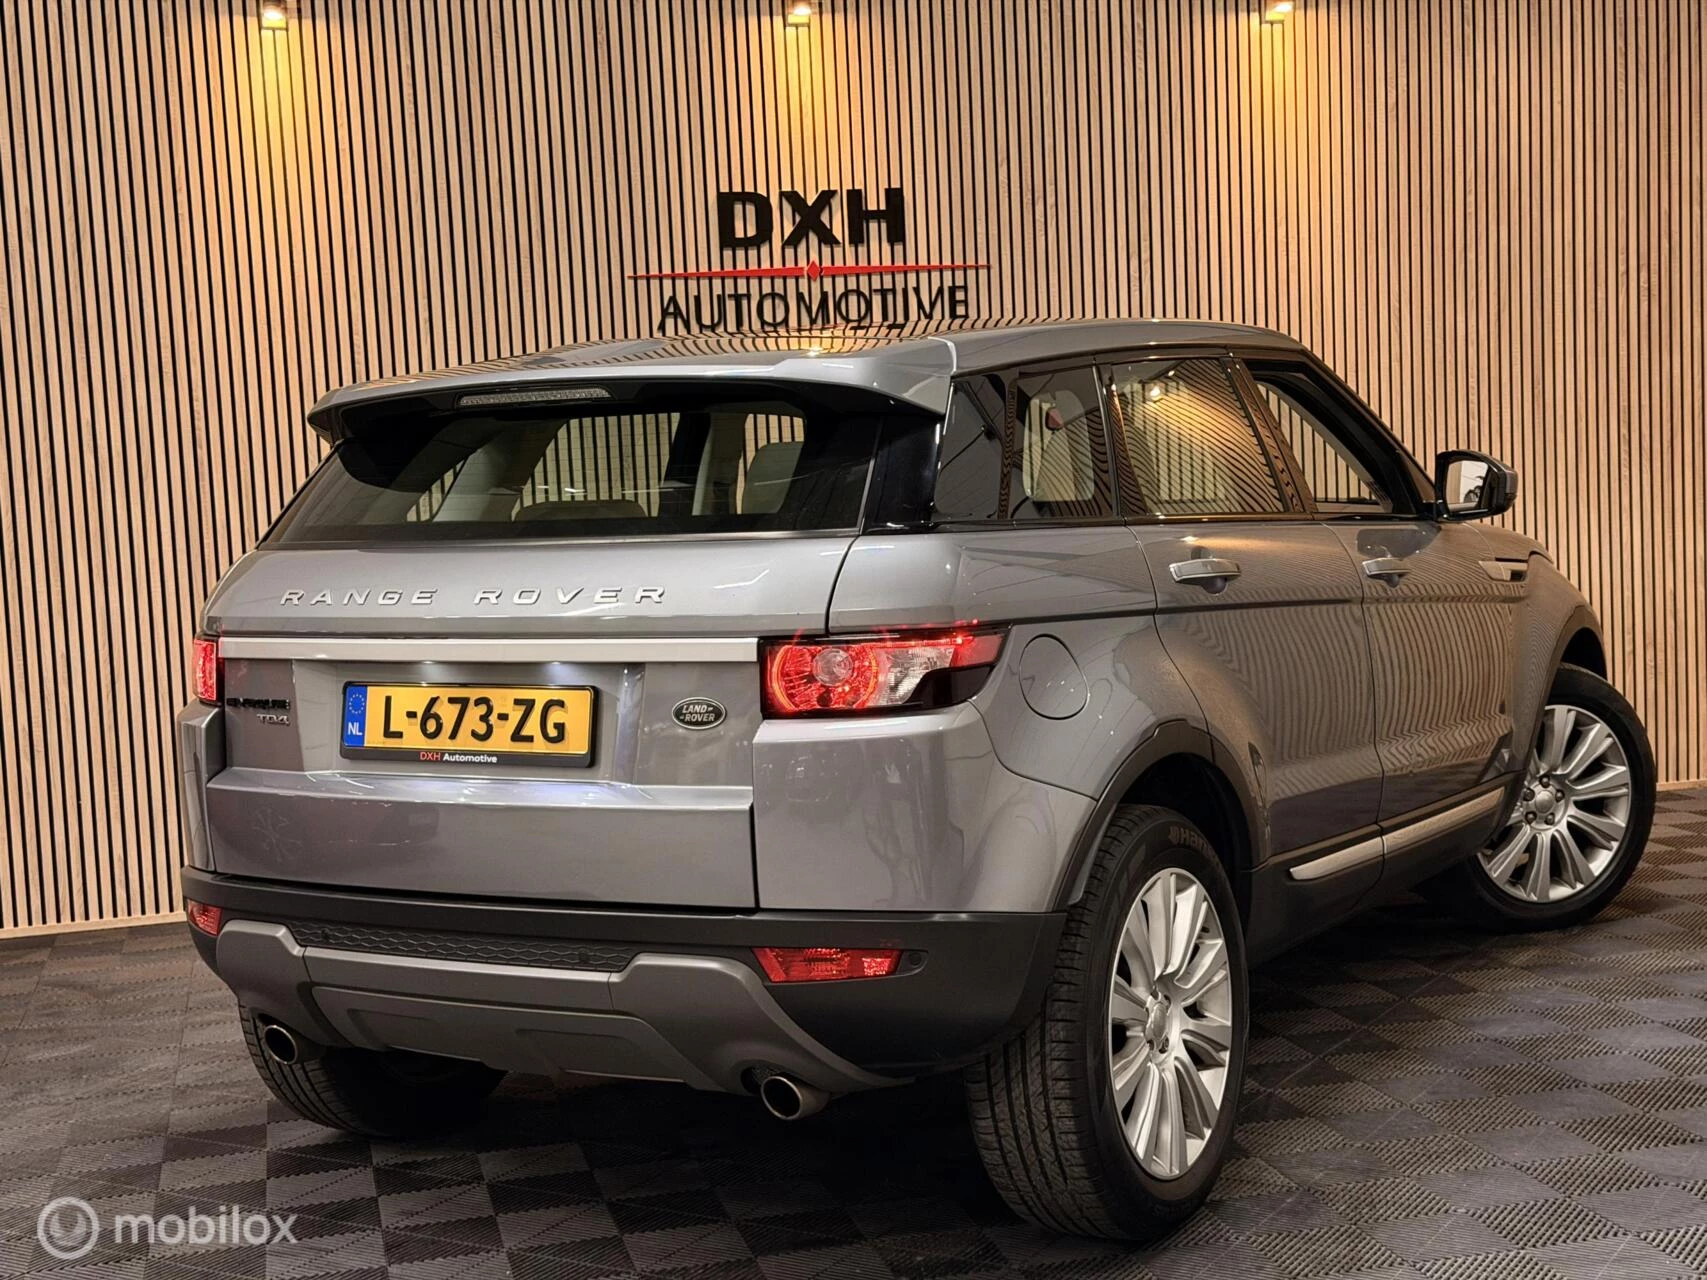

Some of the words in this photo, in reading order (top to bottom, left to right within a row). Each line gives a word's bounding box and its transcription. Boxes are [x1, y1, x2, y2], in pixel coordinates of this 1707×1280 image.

[718, 187, 905, 249] DXH
[658, 285, 969, 332] AUTOMOTIVE
[281, 588, 437, 606] RANGE
[474, 585, 668, 605] ROVER
[347, 721, 363, 736] NL
[382, 695, 566, 744] L-673-ZG
[420, 752, 441, 761] DXH
[443, 753, 498, 763] Automotive
